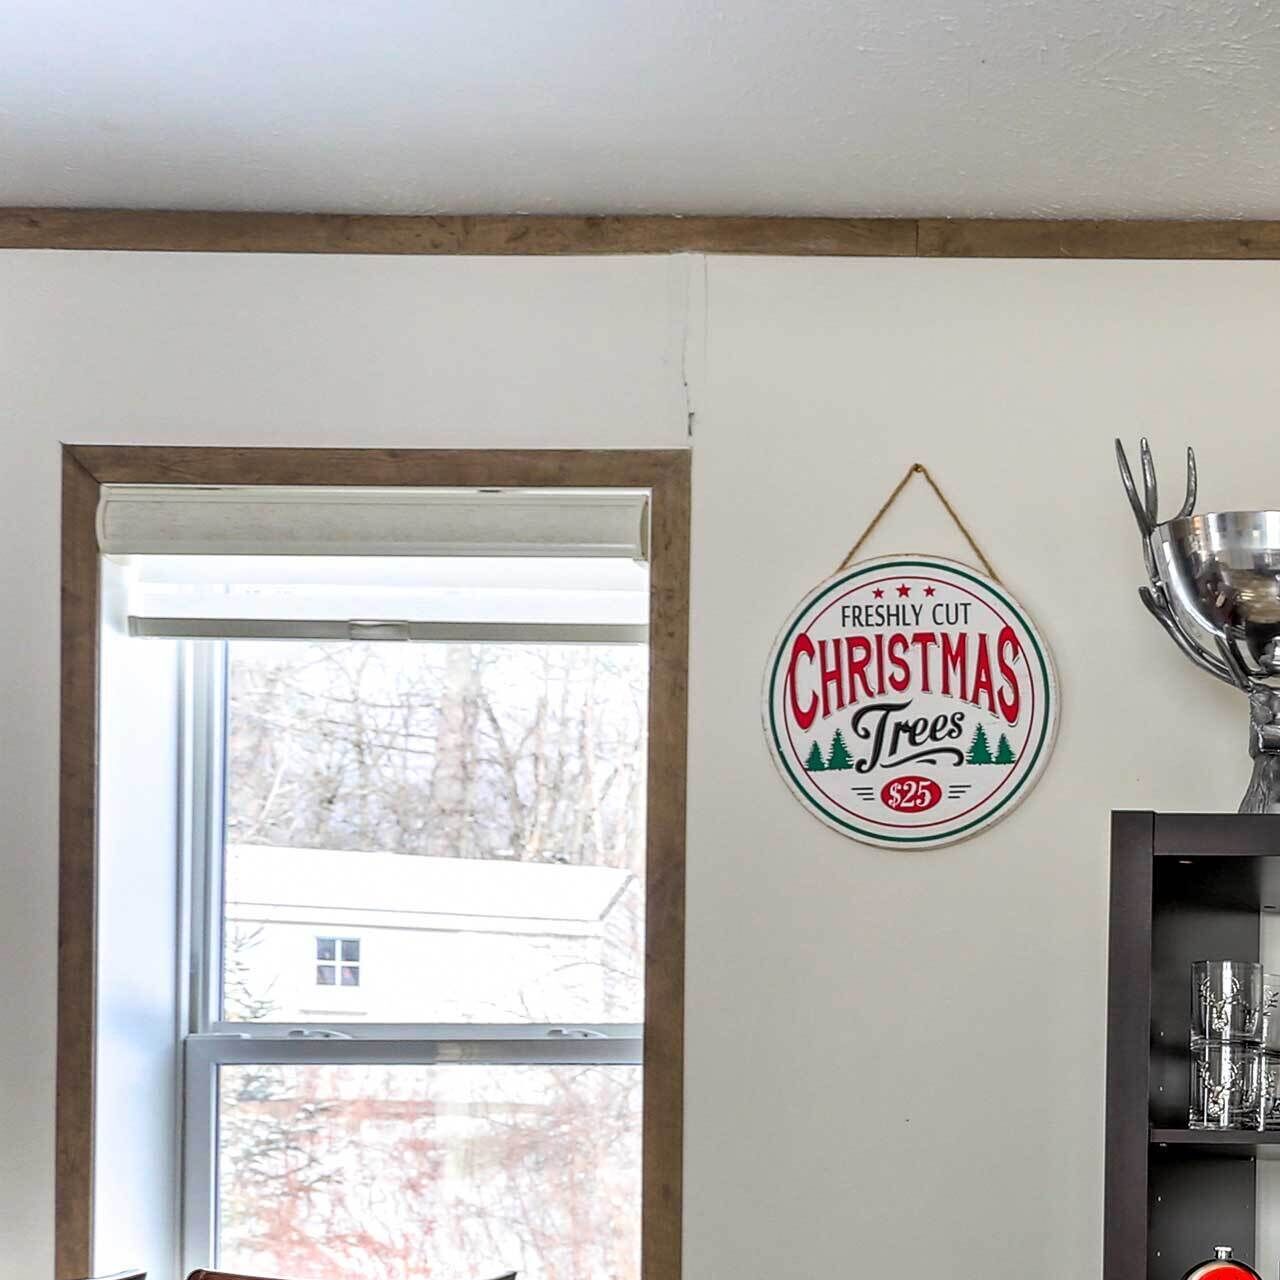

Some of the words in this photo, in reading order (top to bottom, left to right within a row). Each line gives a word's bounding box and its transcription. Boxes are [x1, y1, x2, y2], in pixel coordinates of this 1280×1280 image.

[841, 604, 922, 628] FRESHLY
[932, 602, 972, 625] CUT
[789, 625, 1021, 731] CHRISTMAS
[851, 699, 965, 774] Trees
[888, 780, 932, 808] $25
